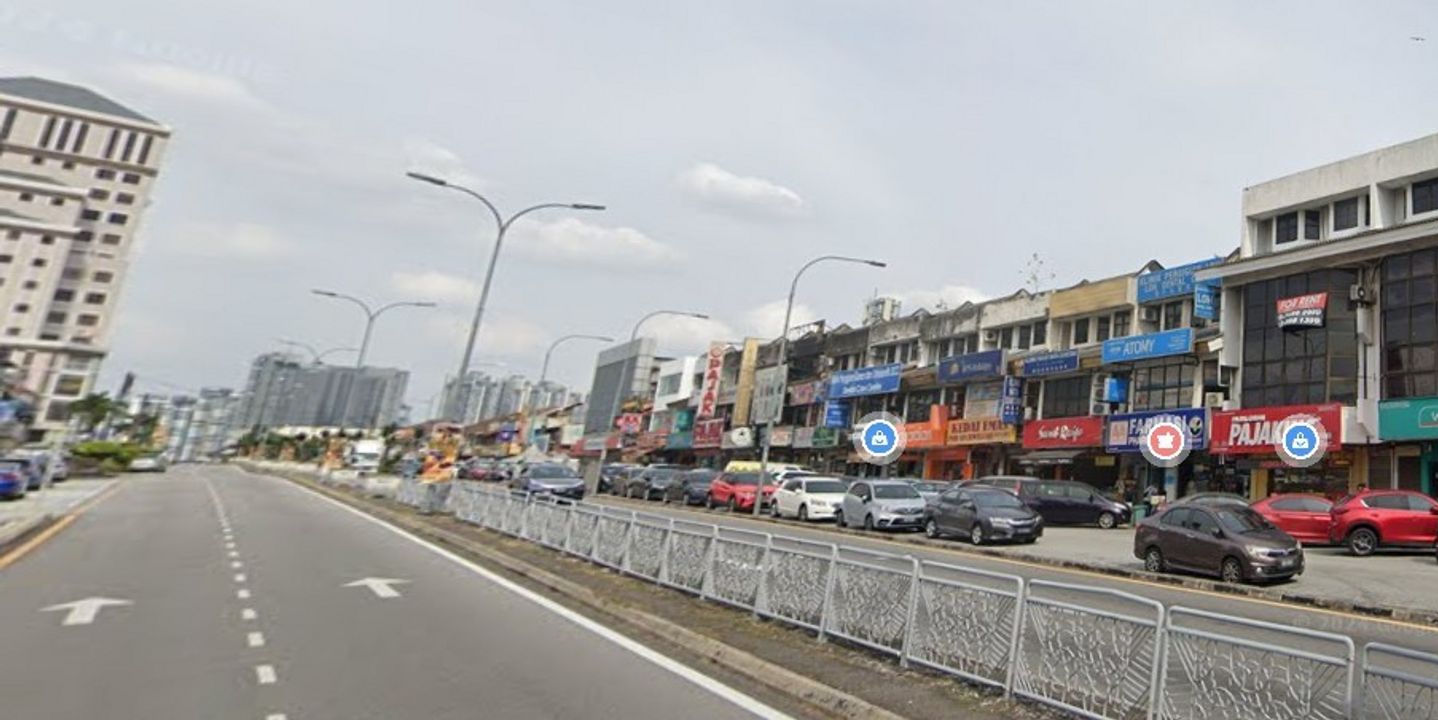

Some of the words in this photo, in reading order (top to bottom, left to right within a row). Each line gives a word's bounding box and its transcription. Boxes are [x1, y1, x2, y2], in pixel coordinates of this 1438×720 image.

[1122, 338, 1156, 357] ATOMY
[701, 358, 721, 413] PAJAK
[951, 420, 980, 434] KEDAI
